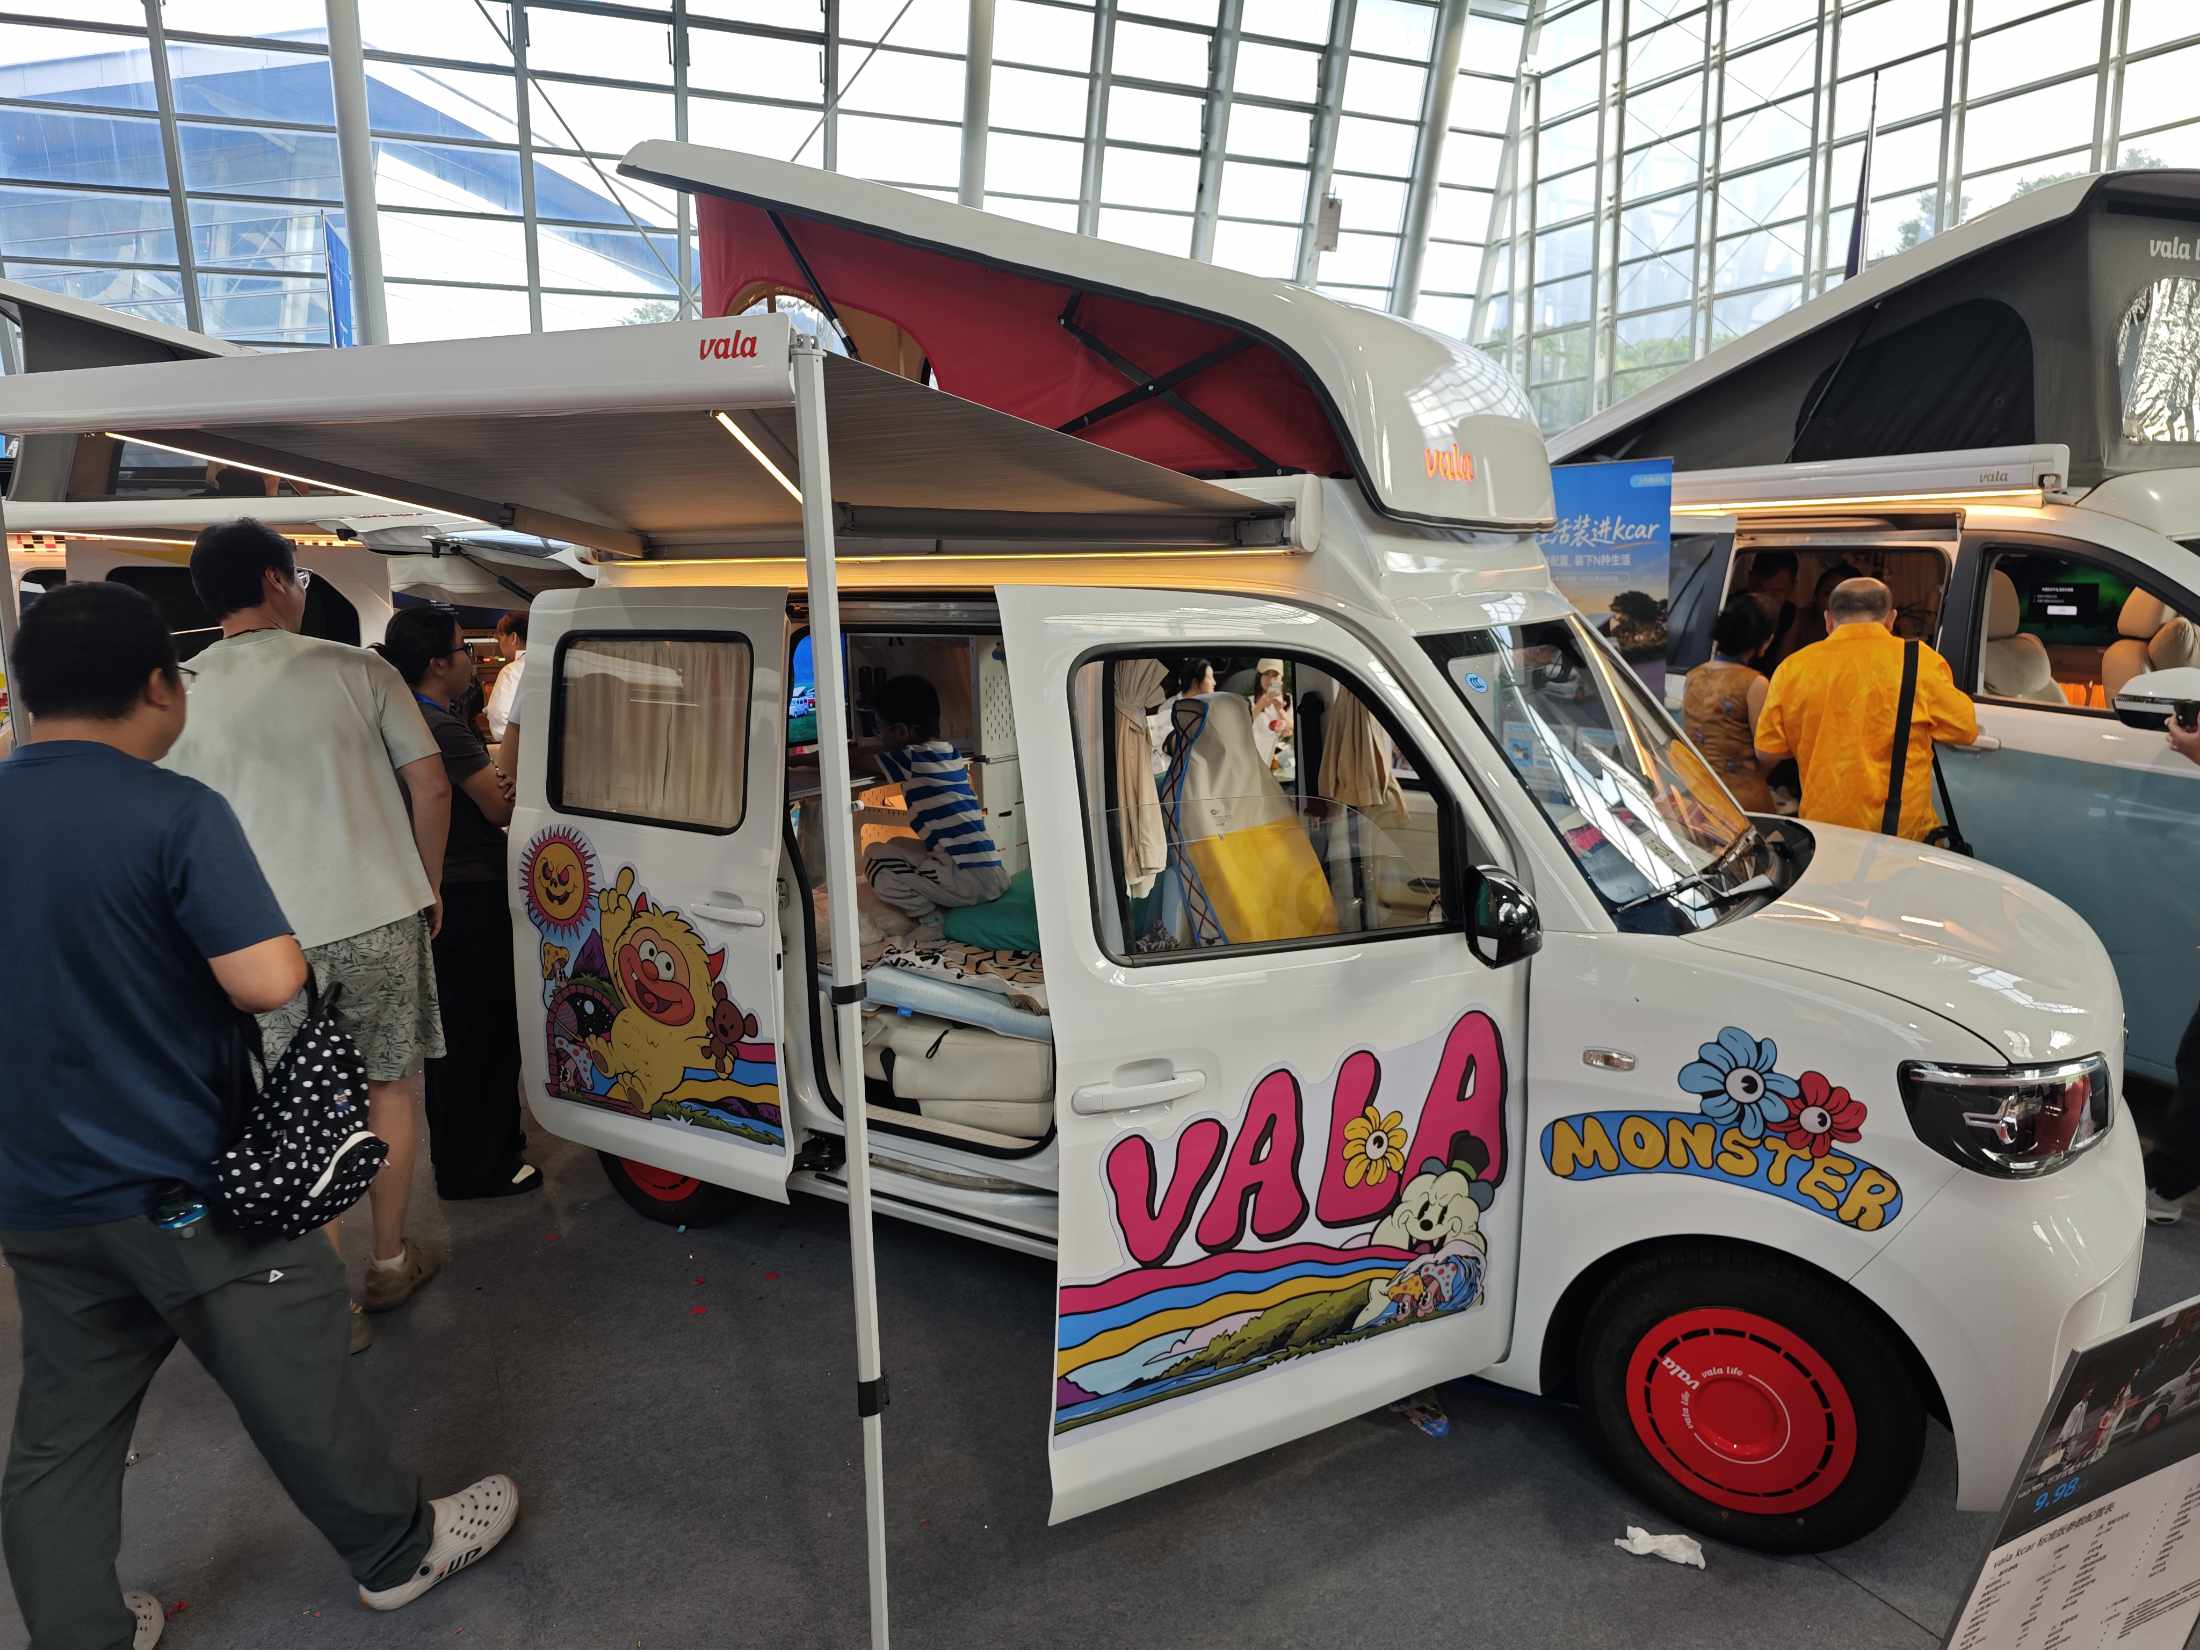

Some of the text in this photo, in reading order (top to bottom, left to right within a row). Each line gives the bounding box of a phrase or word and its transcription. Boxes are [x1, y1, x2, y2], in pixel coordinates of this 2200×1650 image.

[2150, 236, 2190, 260] vala
[699, 329, 758, 360] vala
[1424, 442, 1474, 483] vala
[1977, 470, 2009, 484] vala
[1106, 1010, 1508, 1268] VALA
[1550, 1115, 1899, 1232] MONSTER
[1662, 1356, 1700, 1390] vala
[1702, 1367, 1724, 1378] vala
